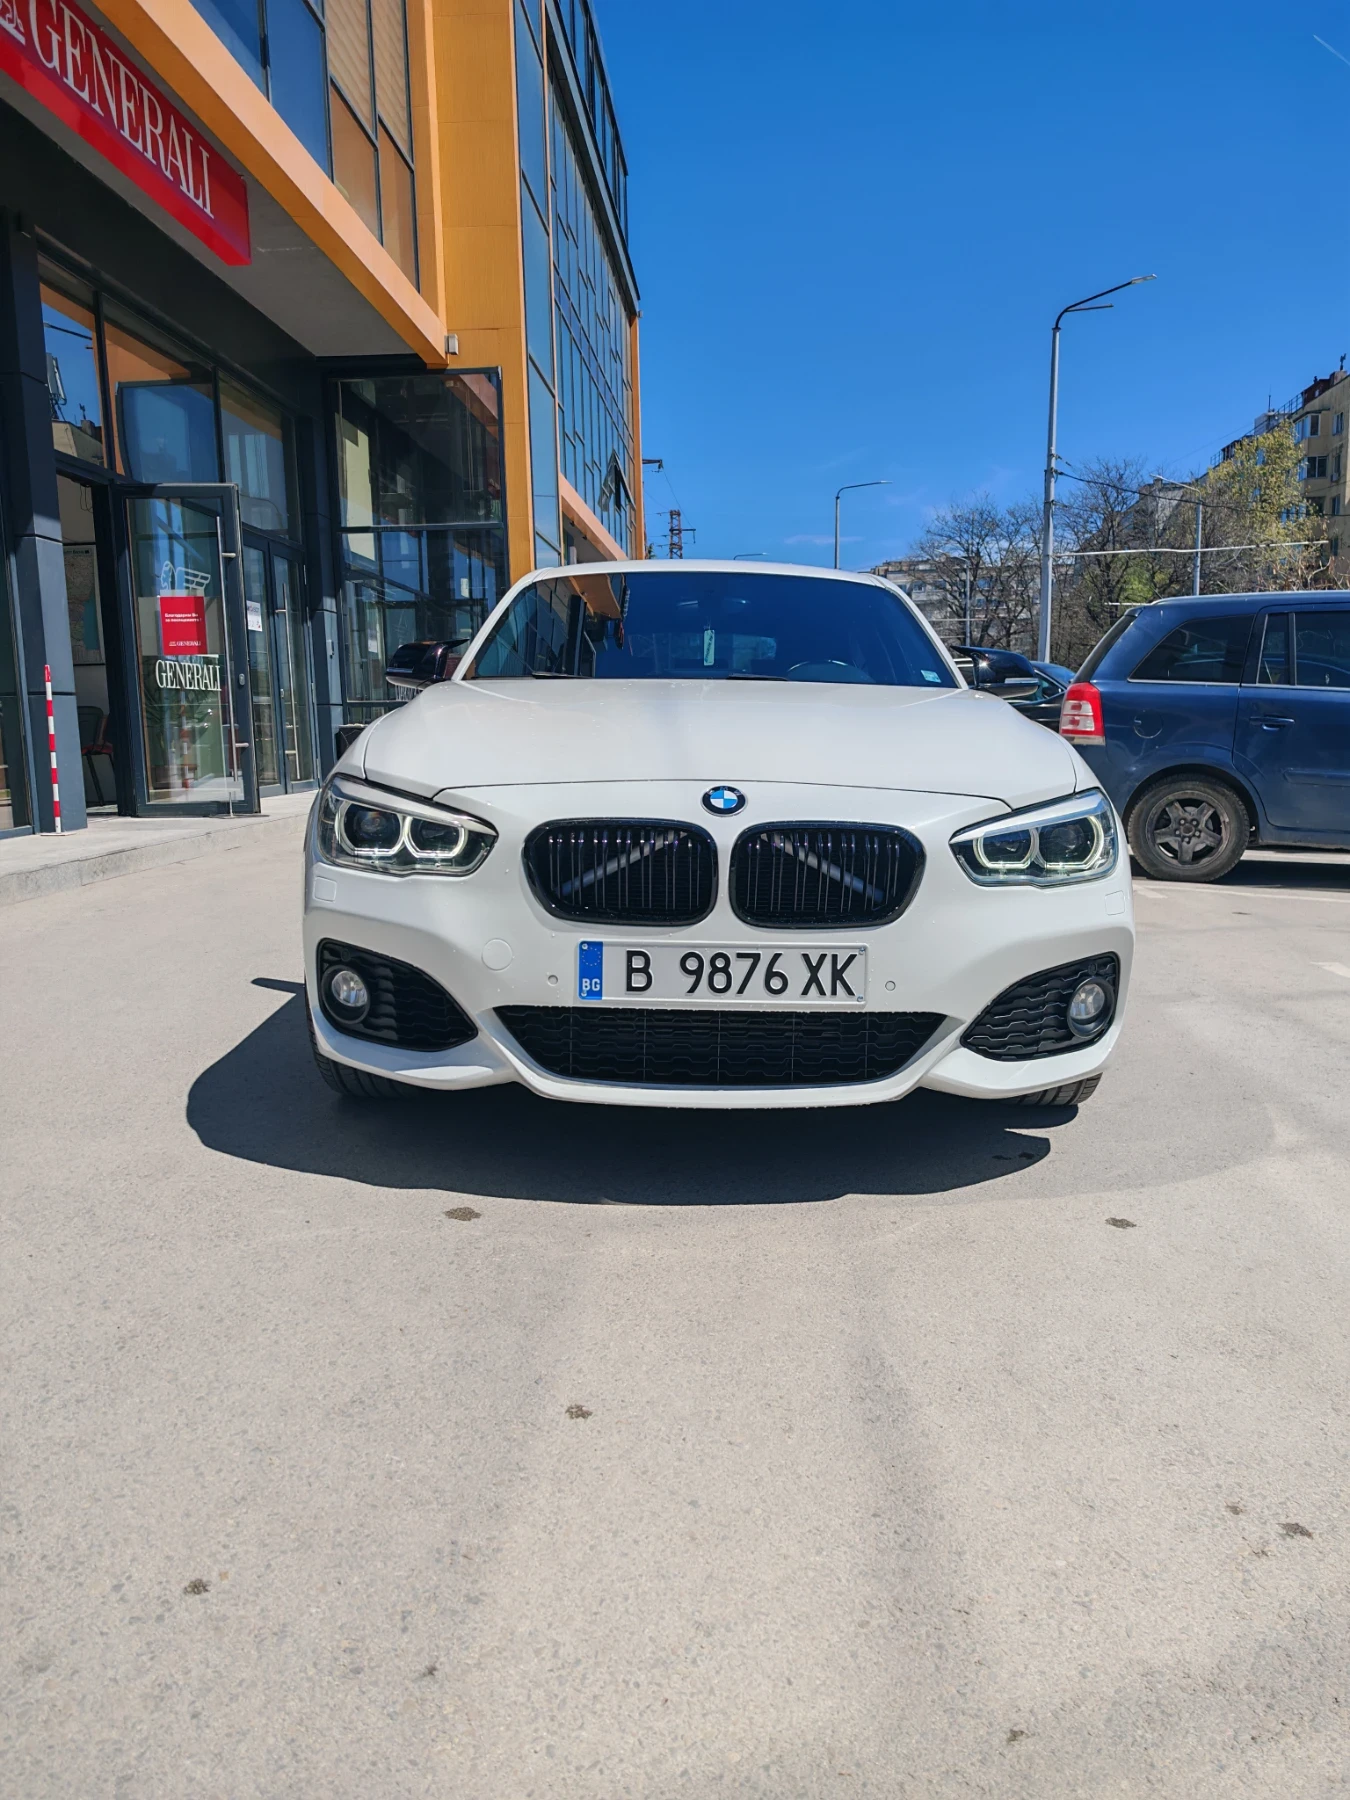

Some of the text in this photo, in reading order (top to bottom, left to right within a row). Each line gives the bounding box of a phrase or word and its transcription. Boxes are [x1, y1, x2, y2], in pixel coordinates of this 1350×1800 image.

[29, 0, 214, 219] GENERALI
[155, 659, 222, 691] GENERALI
[582, 978, 601, 991] BG
[626, 949, 858, 996] B 9876 XK
